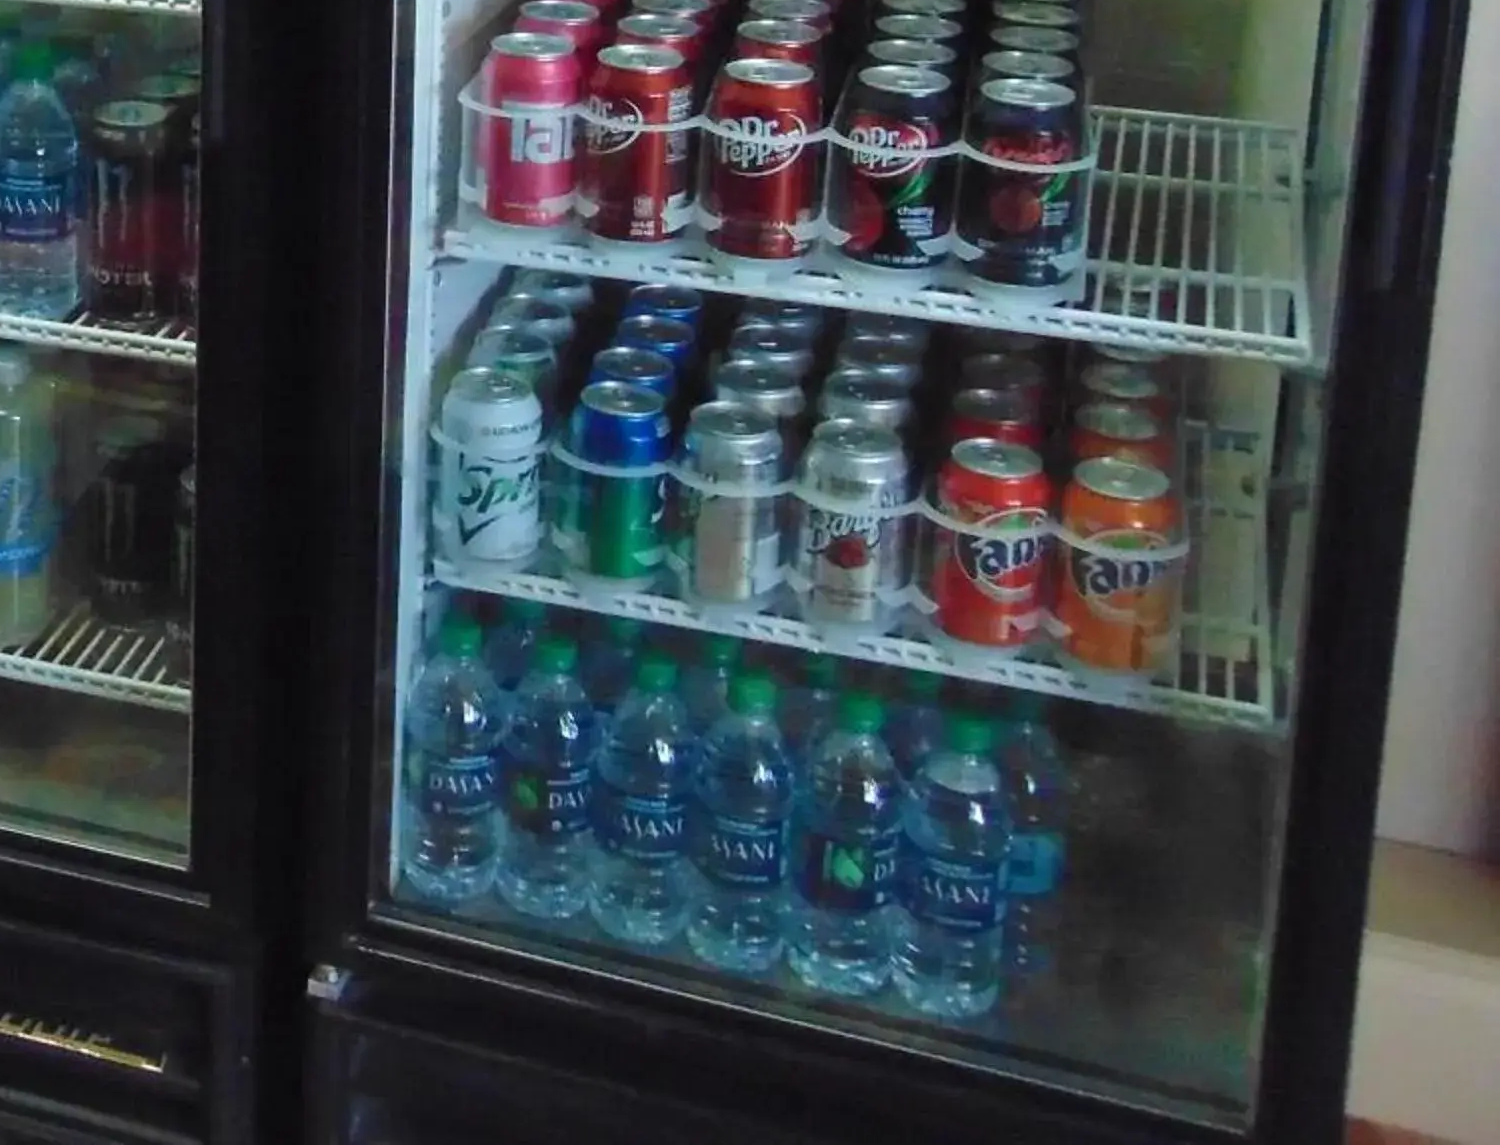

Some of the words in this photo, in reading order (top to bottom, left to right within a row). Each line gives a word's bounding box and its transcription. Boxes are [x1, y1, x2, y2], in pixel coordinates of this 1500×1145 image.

[740, 117, 780, 141] Dr
[870, 126, 901, 148] Dr
[957, 527, 1048, 581] Fan
[1072, 545, 1168, 599] Fan
